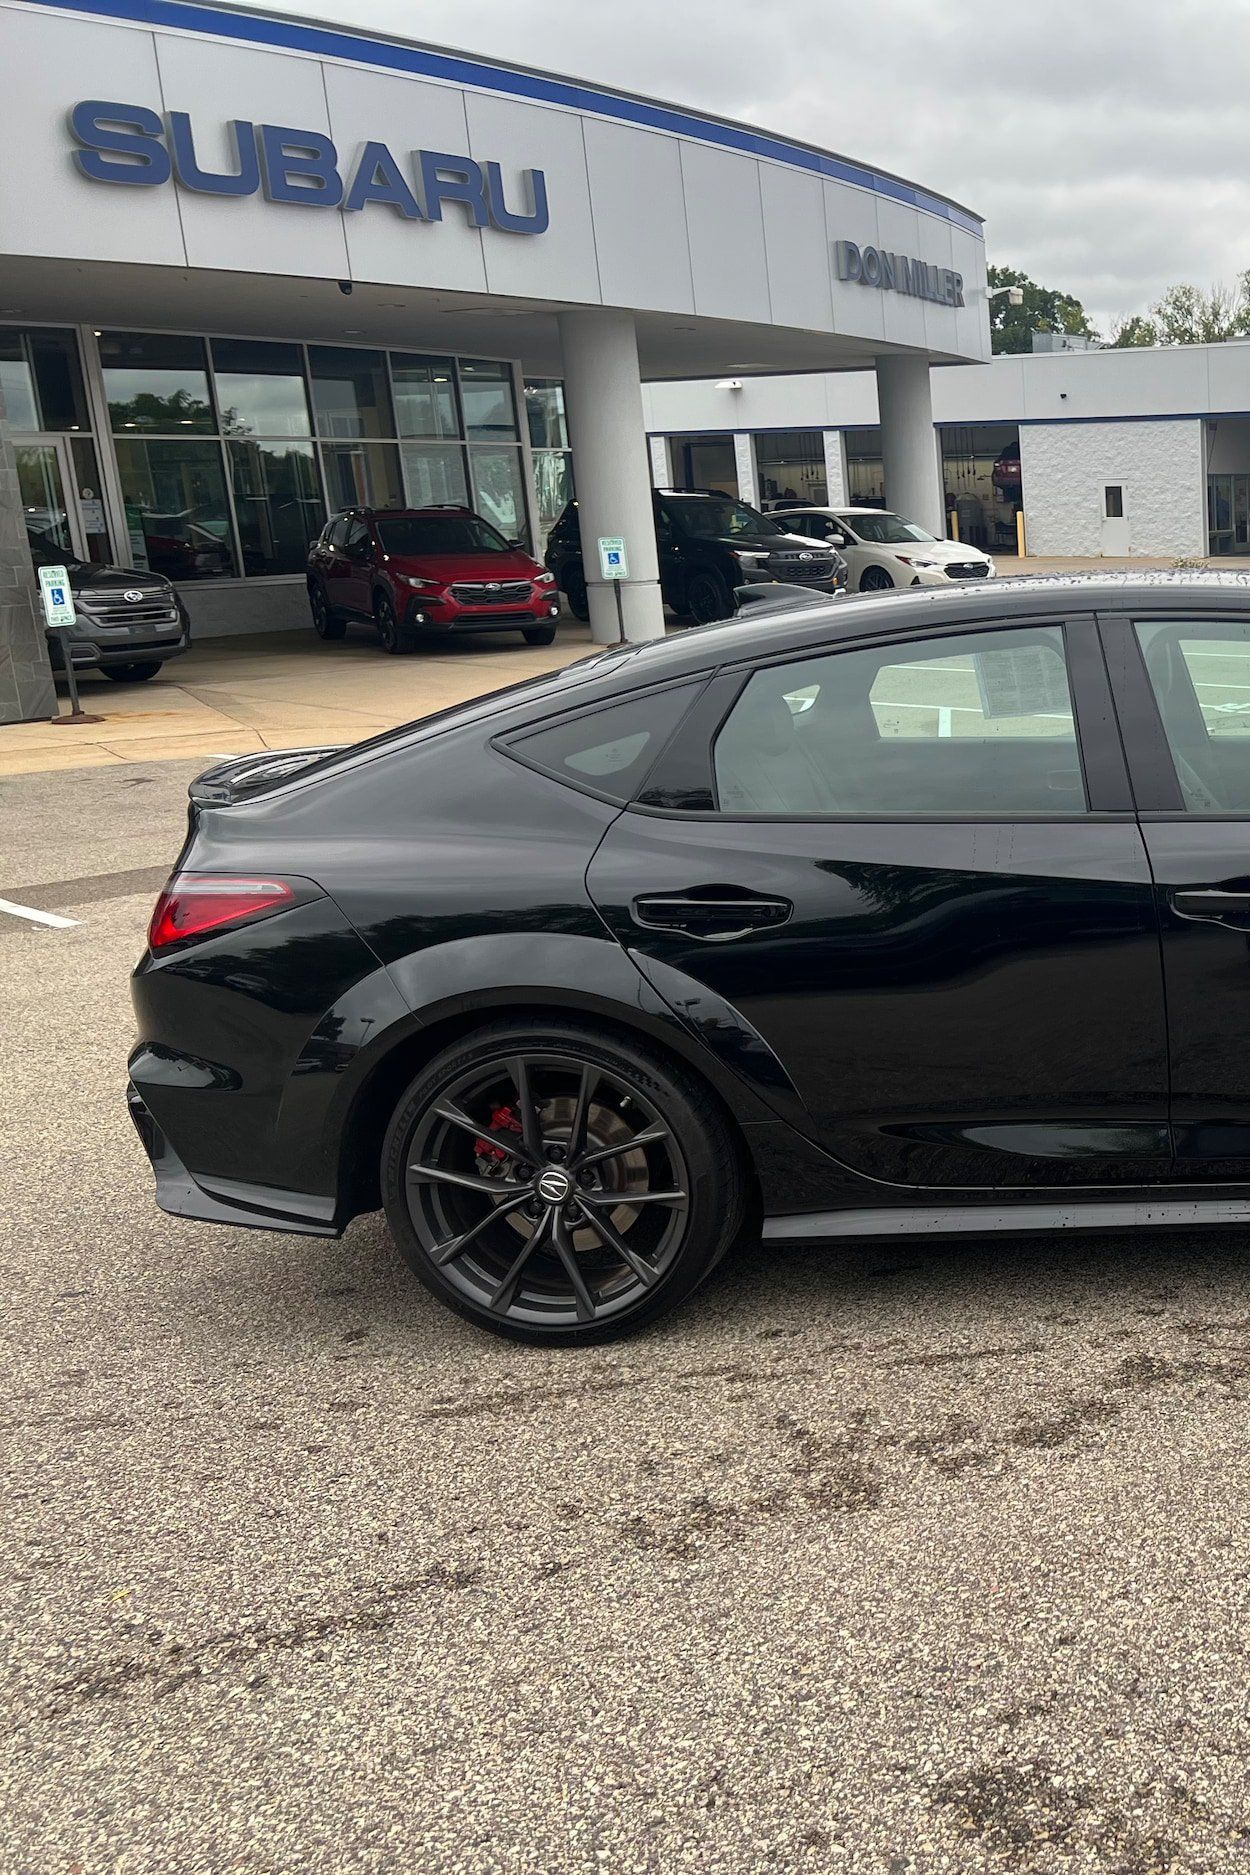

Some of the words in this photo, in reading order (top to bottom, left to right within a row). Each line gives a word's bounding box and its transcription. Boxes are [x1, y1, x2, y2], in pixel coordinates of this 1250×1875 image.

[67, 100, 549, 234] SUBARU
[836, 240, 896, 290] DON
[895, 254, 965, 307] MILLER
